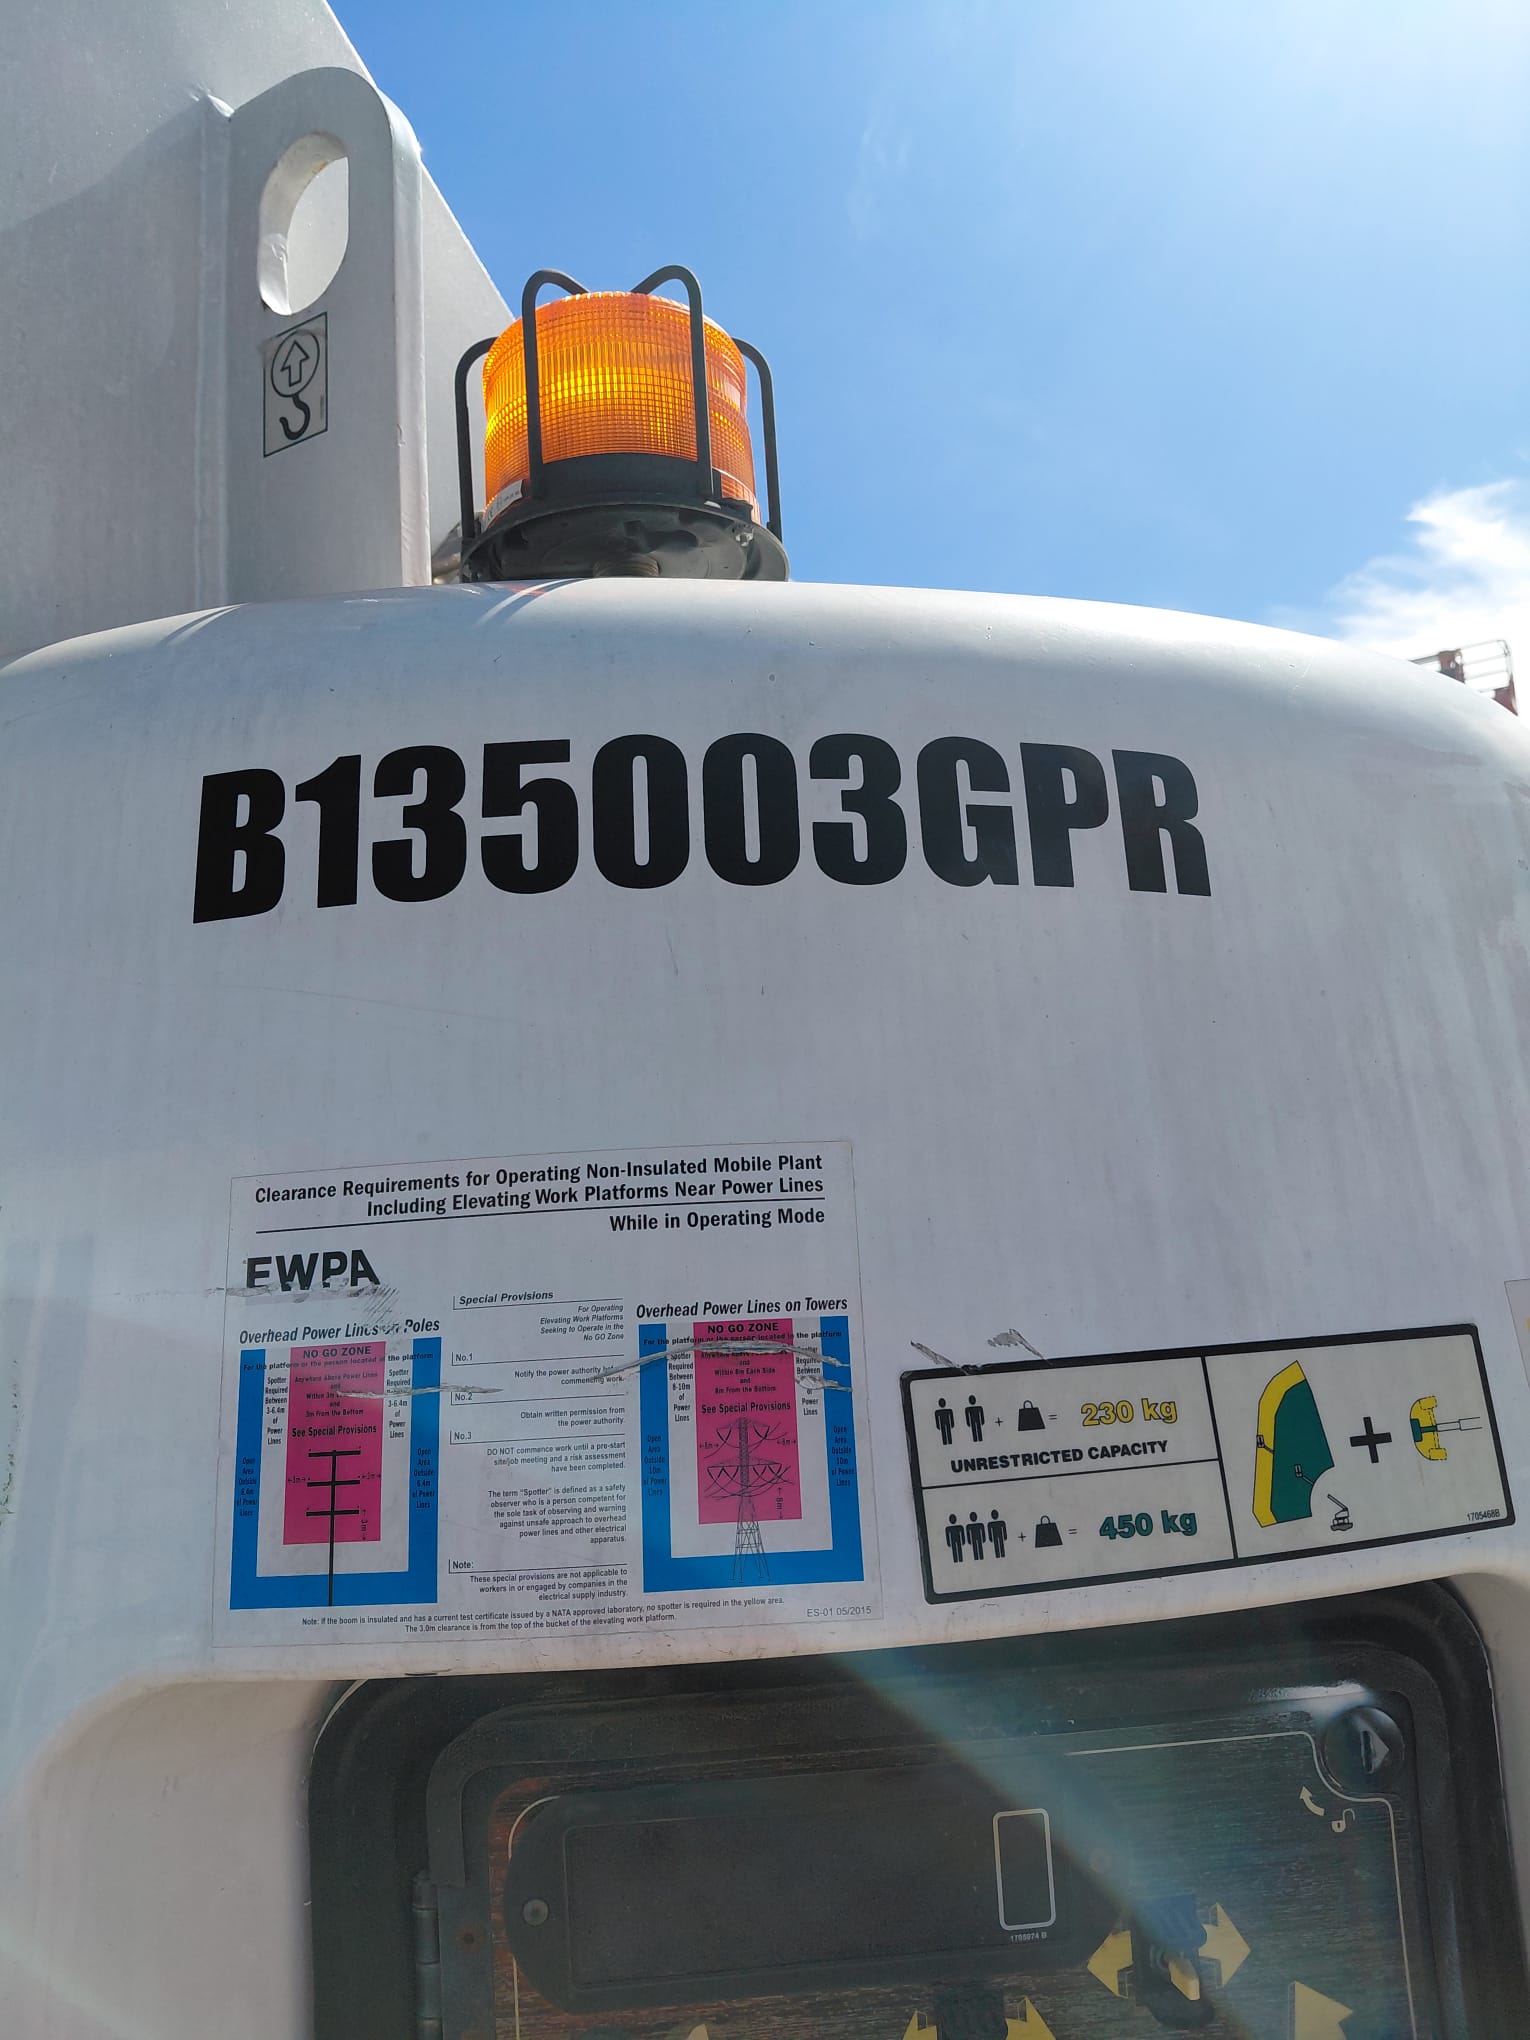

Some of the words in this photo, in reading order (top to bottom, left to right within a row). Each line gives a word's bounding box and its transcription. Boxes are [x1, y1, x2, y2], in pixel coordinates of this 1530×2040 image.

[193, 732, 1212, 924] B135003GPR
[255, 1185, 336, 1202] Clearance
[343, 1174, 460, 1196] Requirements
[465, 1170, 490, 1186] for
[495, 1166, 580, 1186] Operating
[586, 1158, 707, 1178] Non-Insulated
[714, 1156, 772, 1172] Mobile
[778, 1154, 822, 1170] Plant
[367, 1197, 447, 1216] Including
[452, 1191, 531, 1210] Elevating
[534, 1187, 578, 1204] Work
[584, 1184, 668, 1201] Platforms
[674, 1181, 716, 1196] Near
[721, 1179, 773, 1194] Power
[779, 1177, 823, 1192] Lines
[609, 1214, 658, 1231] While
[664, 1212, 680, 1228] in
[686, 1210, 772, 1230] Operating
[777, 1207, 824, 1223] Mode
[246, 1249, 381, 1291] EWPA
[458, 1293, 497, 1306] Special
[500, 1291, 553, 1301] Provisions
[577, 1304, 590, 1312] For
[590, 1304, 623, 1313] Operating
[636, 1302, 698, 1318] Overhead
[702, 1301, 743, 1315] Power
[746, 1299, 780, 1313] Lines
[785, 1300, 801, 1312] on
[804, 1297, 847, 1310] Towers
[591, 1313, 623, 1321] Platforms
[239, 1327, 298, 1344] Overhead
[301, 1326, 341, 1340] Power
[344, 1322, 380, 1337] Lines
[404, 1318, 440, 1333] Poles
[540, 1326, 567, 1334] Seeking
[577, 1324, 603, 1333] Operate
[604, 1323, 611, 1333] in
[707, 1324, 724, 1334] NO
[727, 1323, 744, 1334] GO
[748, 1322, 779, 1333] ZONE
[302, 1349, 318, 1358] NO
[322, 1348, 338, 1357] GO
[341, 1345, 372, 1356] ZONE
[455, 1352, 472, 1361] No.1
[514, 1369, 534, 1378] Notify
[548, 1369, 569, 1377] power
[570, 1366, 601, 1376] authority
[455, 1393, 473, 1401] No.2
[520, 1410, 542, 1418] Obtain
[569, 1407, 607, 1417] permission
[608, 1406, 625, 1414] from
[701, 1404, 716, 1415] See
[719, 1402, 747, 1415] Special
[750, 1400, 791, 1411] Provisions
[1080, 1400, 1134, 1427] 230
[1141, 1398, 1178, 1424] kg
[570, 1419, 591, 1428] power
[291, 1427, 306, 1440] See
[308, 1425, 335, 1438] Special
[337, 1423, 376, 1434] Provisions
[453, 1431, 471, 1440] No.3
[487, 1448, 497, 1456] DO
[499, 1446, 514, 1455] NOT
[555, 1443, 571, 1451] work
[573, 1442, 588, 1452] until
[596, 1441, 625, 1451] pre-start
[950, 1449, 1084, 1472] UNRESTRICTED
[1088, 1440, 1168, 1460] CAPACITY
[493, 1457, 519, 1466] site/job
[520, 1455, 548, 1464] meeting
[549, 1454, 562, 1462] and
[569, 1453, 583, 1461] risk
[584, 1451, 626, 1460] assessment
[587, 1460, 626, 1471] completed.
[1099, 1512, 1154, 1540] 450
[1160, 1510, 1198, 1536] kg
[452, 1560, 474, 1569] Note:
[492, 1573, 517, 1583] special
[518, 1572, 555, 1582] provisions
[582, 1568, 618, 1579] applicable
[526, 1582, 556, 1592] engaged
[557, 1581, 566, 1591] by
[567, 1579, 606, 1589] companies
[538, 1592, 570, 1600] electrical
[572, 1590, 595, 1600] supply
[367, 1615, 398, 1623] insulated
[474, 1611, 508, 1620] certificate
[510, 1610, 533, 1618] issued
[535, 1610, 544, 1619] by
[551, 1608, 571, 1616] NATA
[572, 1606, 605, 1617] approved
[607, 1605, 644, 1613] laboratory,
[657, 1602, 682, 1612] spotter
[691, 1599, 720, 1609] required
[743, 1597, 765, 1607] yellow
[806, 1607, 832, 1617] ES-01
[836, 1605, 871, 1615] 05/2015
